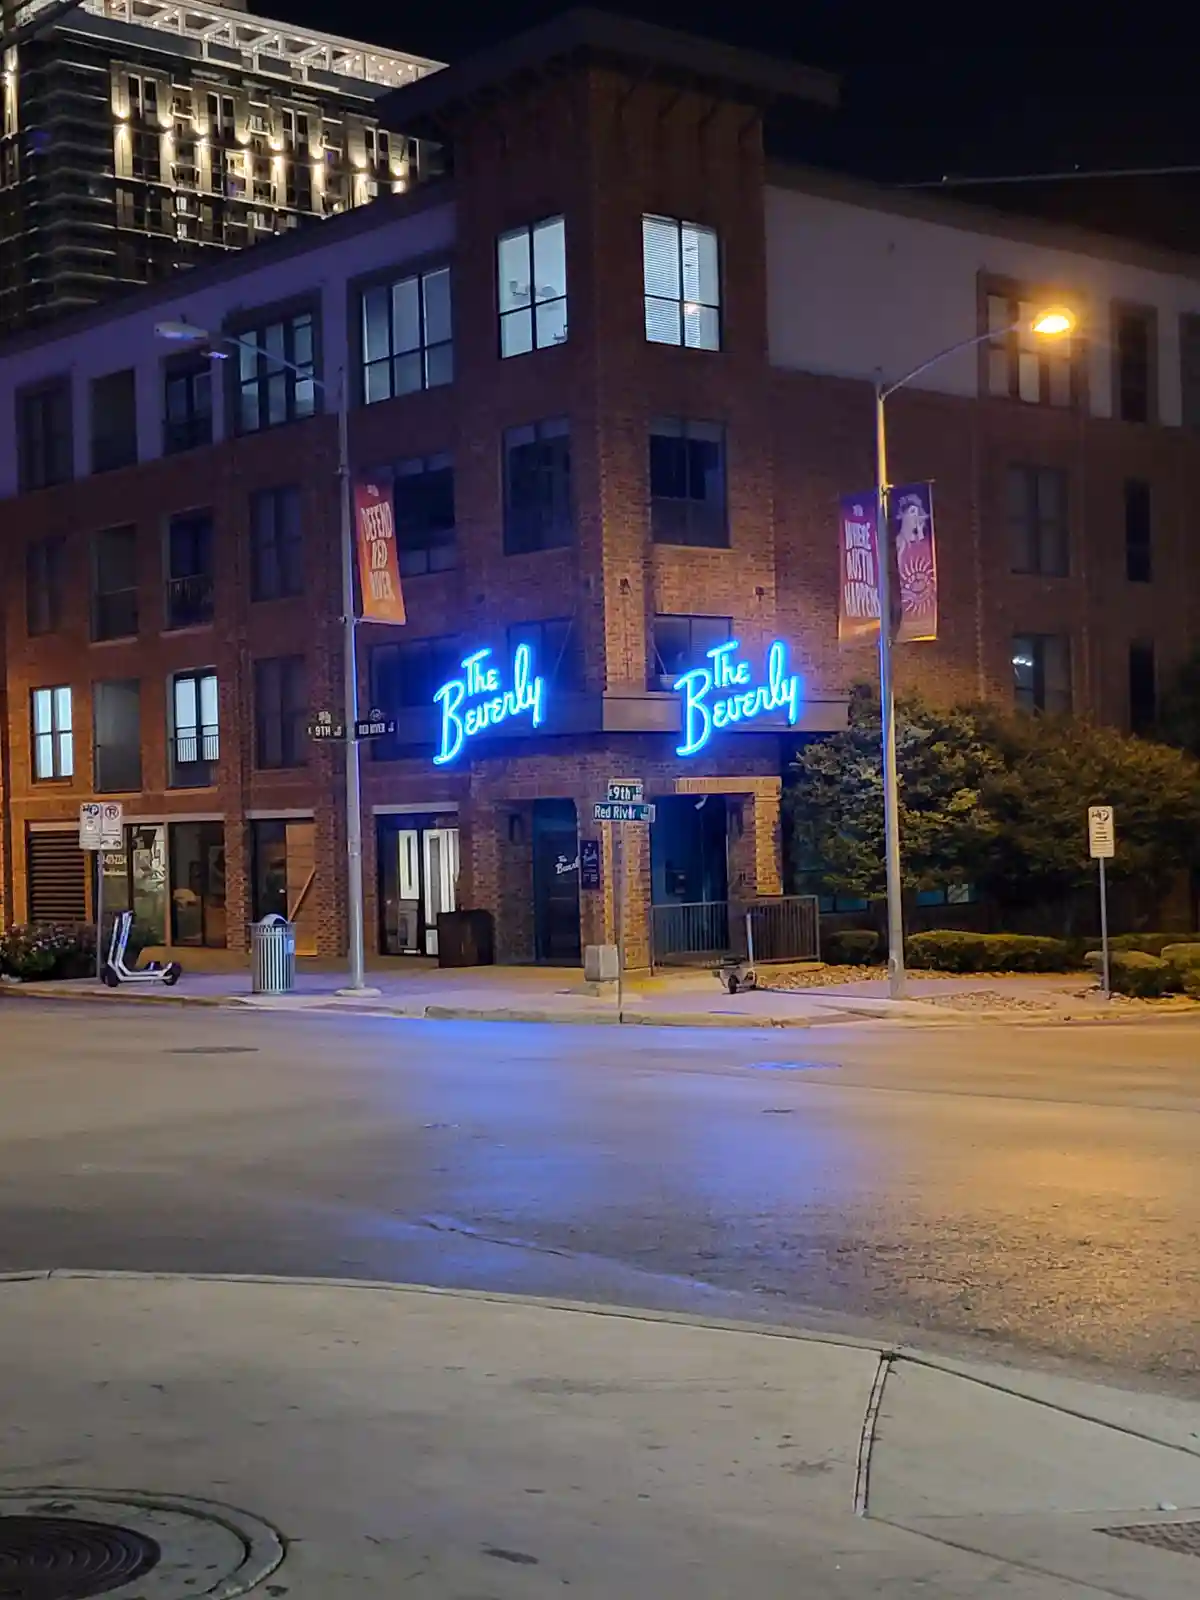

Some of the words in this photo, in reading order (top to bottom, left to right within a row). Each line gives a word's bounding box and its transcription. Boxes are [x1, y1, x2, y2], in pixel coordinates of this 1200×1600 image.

[361, 501, 392, 541] DEFEND
[844, 519, 871, 550] WHERE
[371, 539, 388, 570] RED
[846, 548, 874, 586] AUSTIN
[461, 647, 499, 696] The
[706, 640, 749, 688] The
[432, 643, 544, 766] Beverly
[673, 640, 799, 757] Beverly
[315, 725, 331, 737] 9TH
[594, 805, 612, 819] Red
[613, 786, 631, 800] 9th
